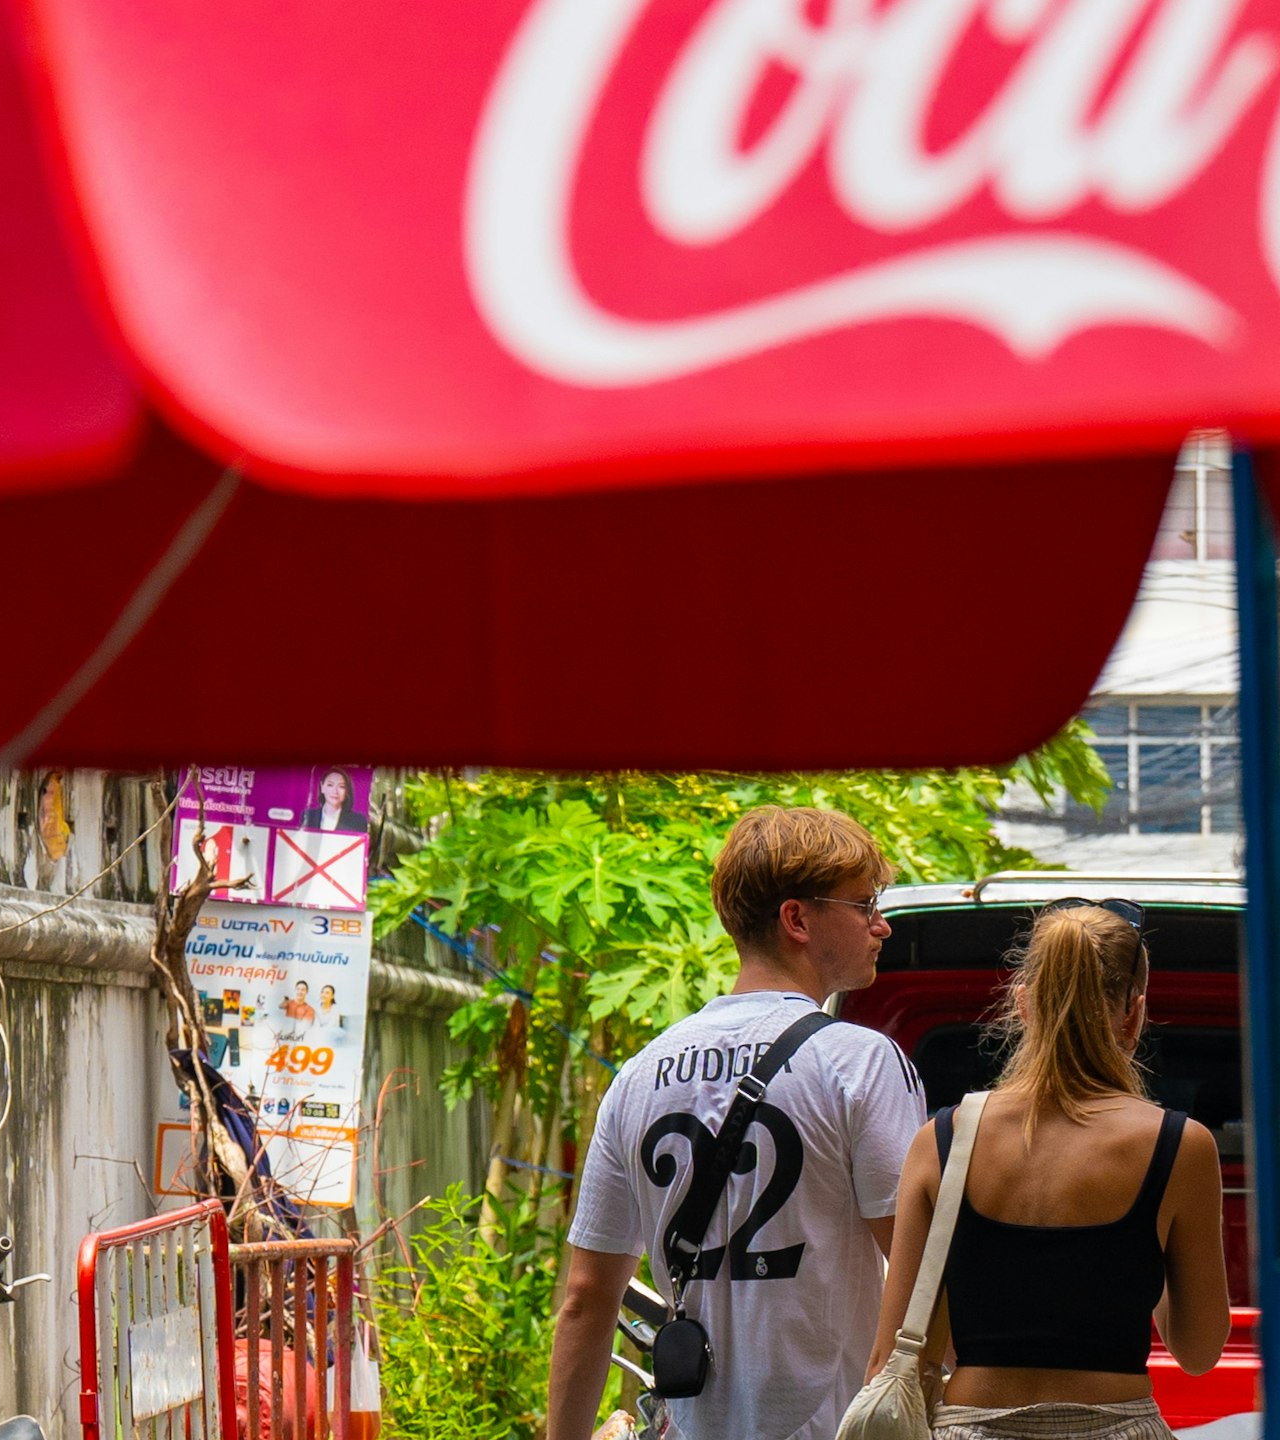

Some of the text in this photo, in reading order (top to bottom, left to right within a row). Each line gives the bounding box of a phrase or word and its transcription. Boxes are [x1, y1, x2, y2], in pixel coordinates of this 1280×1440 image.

[311, 916, 362, 935] 3BB
[265, 1044, 334, 1076] 499
[654, 1042, 793, 1092] RÜDIGE
[640, 1101, 806, 1281] 22
